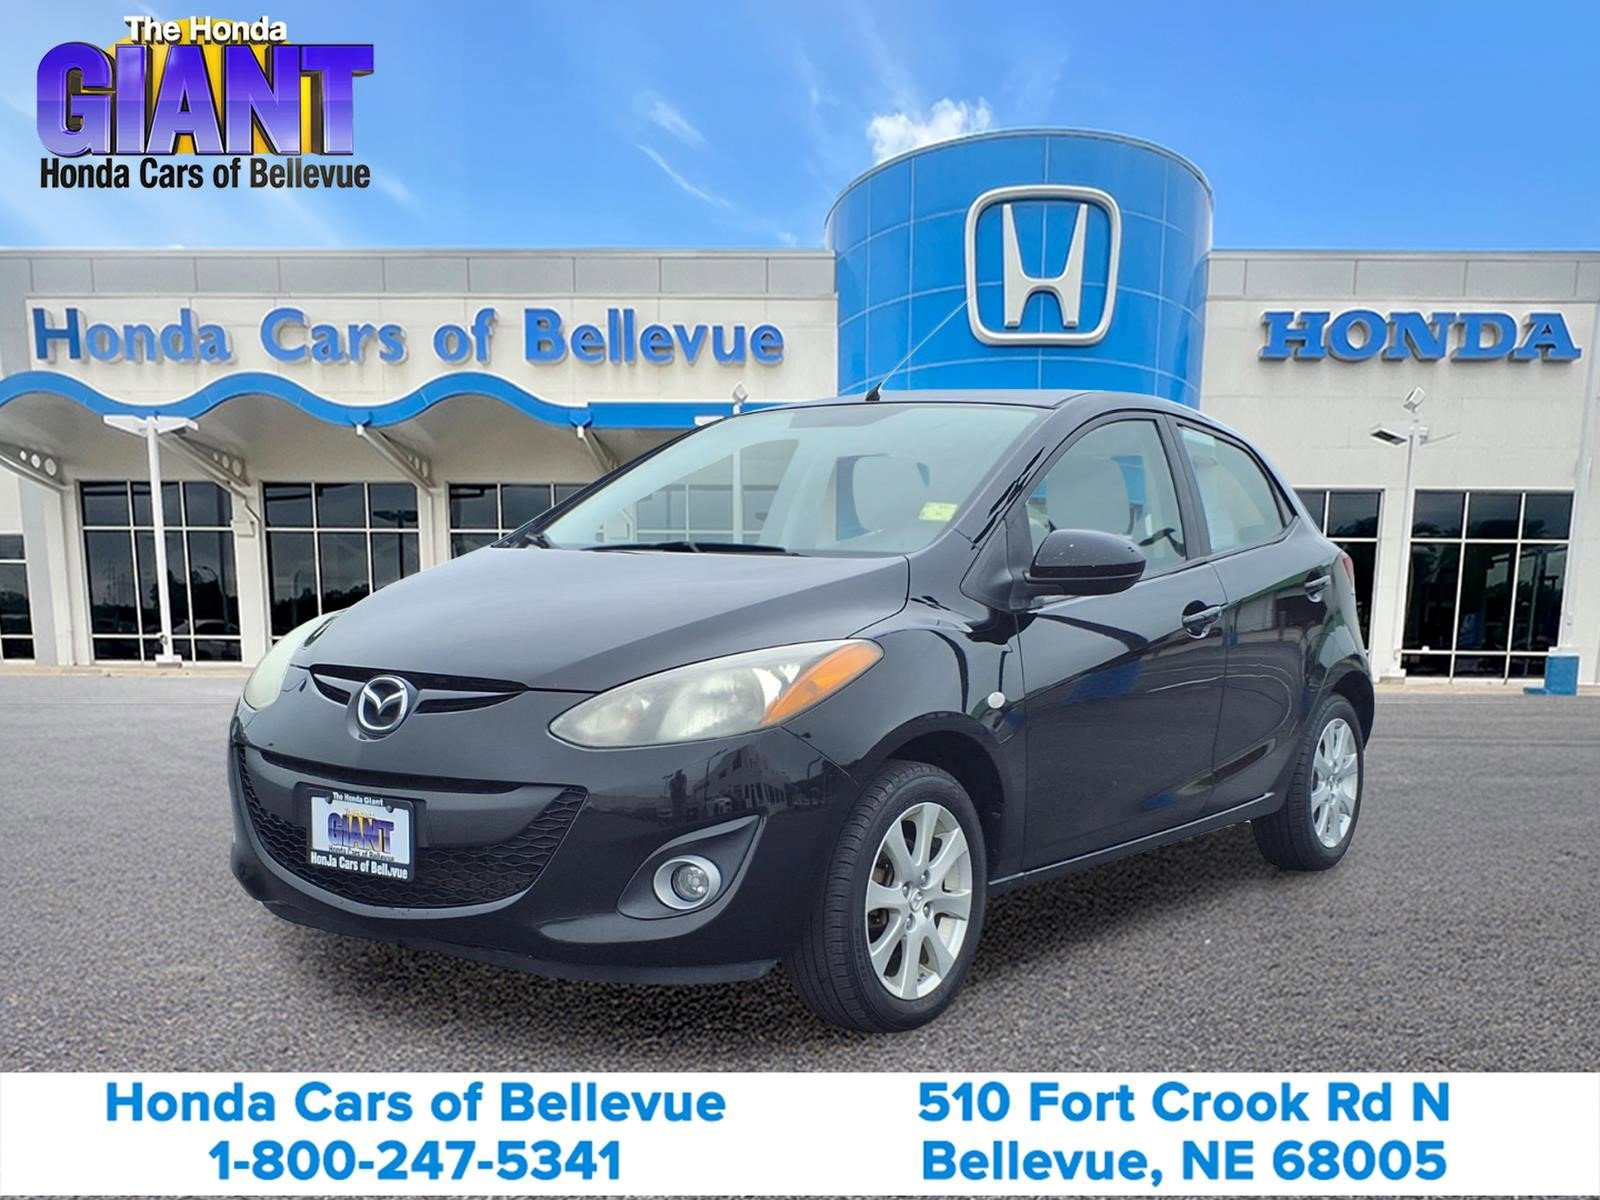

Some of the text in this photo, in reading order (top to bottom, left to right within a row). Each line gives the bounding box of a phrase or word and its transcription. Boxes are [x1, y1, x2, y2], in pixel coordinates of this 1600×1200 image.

[32, 306, 785, 365] Honda Cars of Bellevue
[1259, 309, 1582, 362] HONDA
[328, 812, 394, 854] GIANT
[310, 851, 338, 868] Honda
[339, 856, 359, 871] Cars
[360, 860, 370, 873] of
[371, 861, 408, 880] Bellevue
